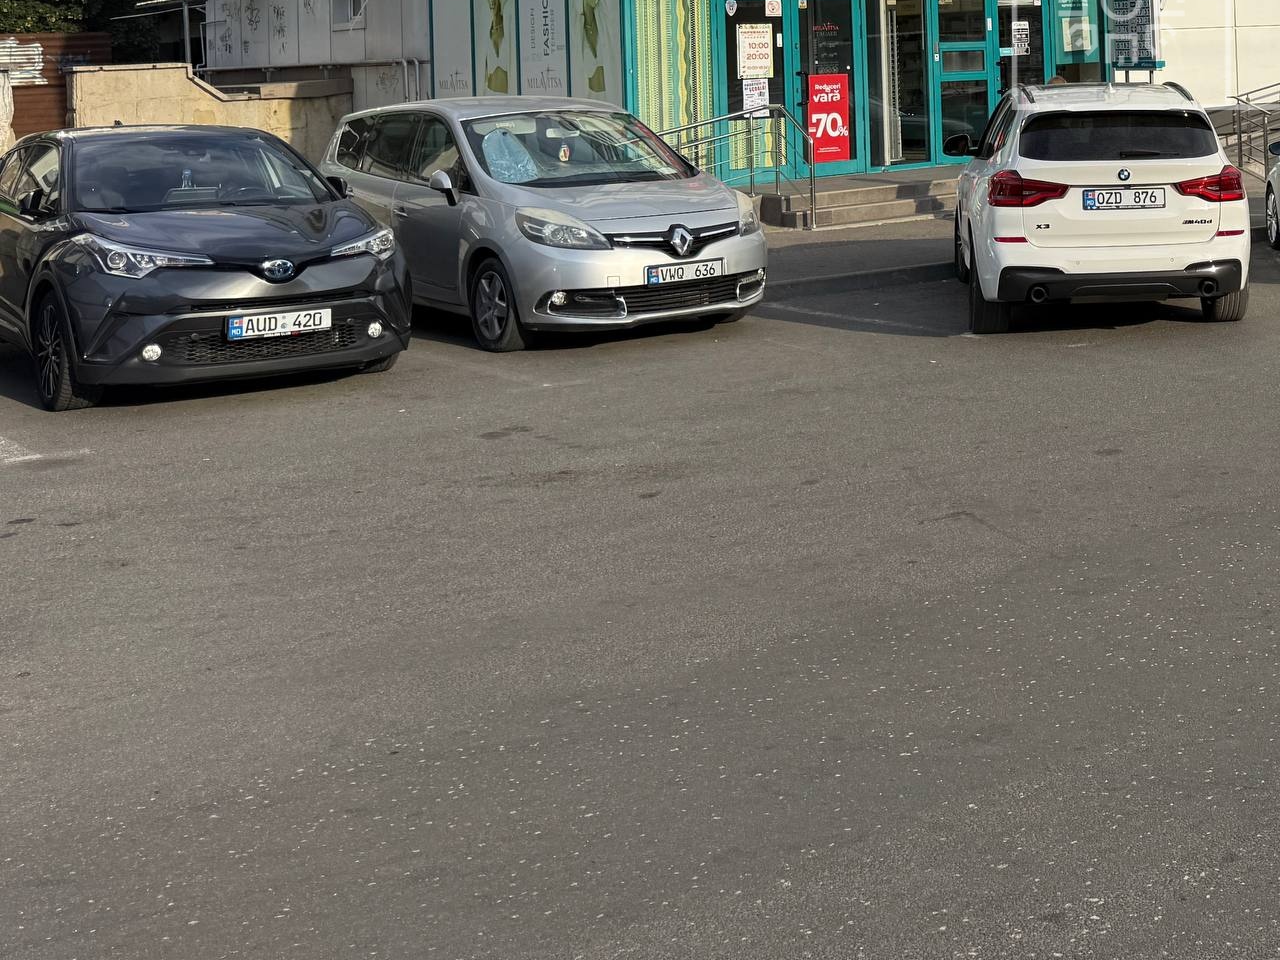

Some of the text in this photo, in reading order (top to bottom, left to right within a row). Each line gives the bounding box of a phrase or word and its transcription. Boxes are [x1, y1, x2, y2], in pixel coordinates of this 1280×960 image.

[809, 112, 848, 138] -70%
[1097, 191, 1157, 205] OZD 876
[660, 265, 716, 282] VWQ 636
[245, 311, 322, 334] AUD 420
